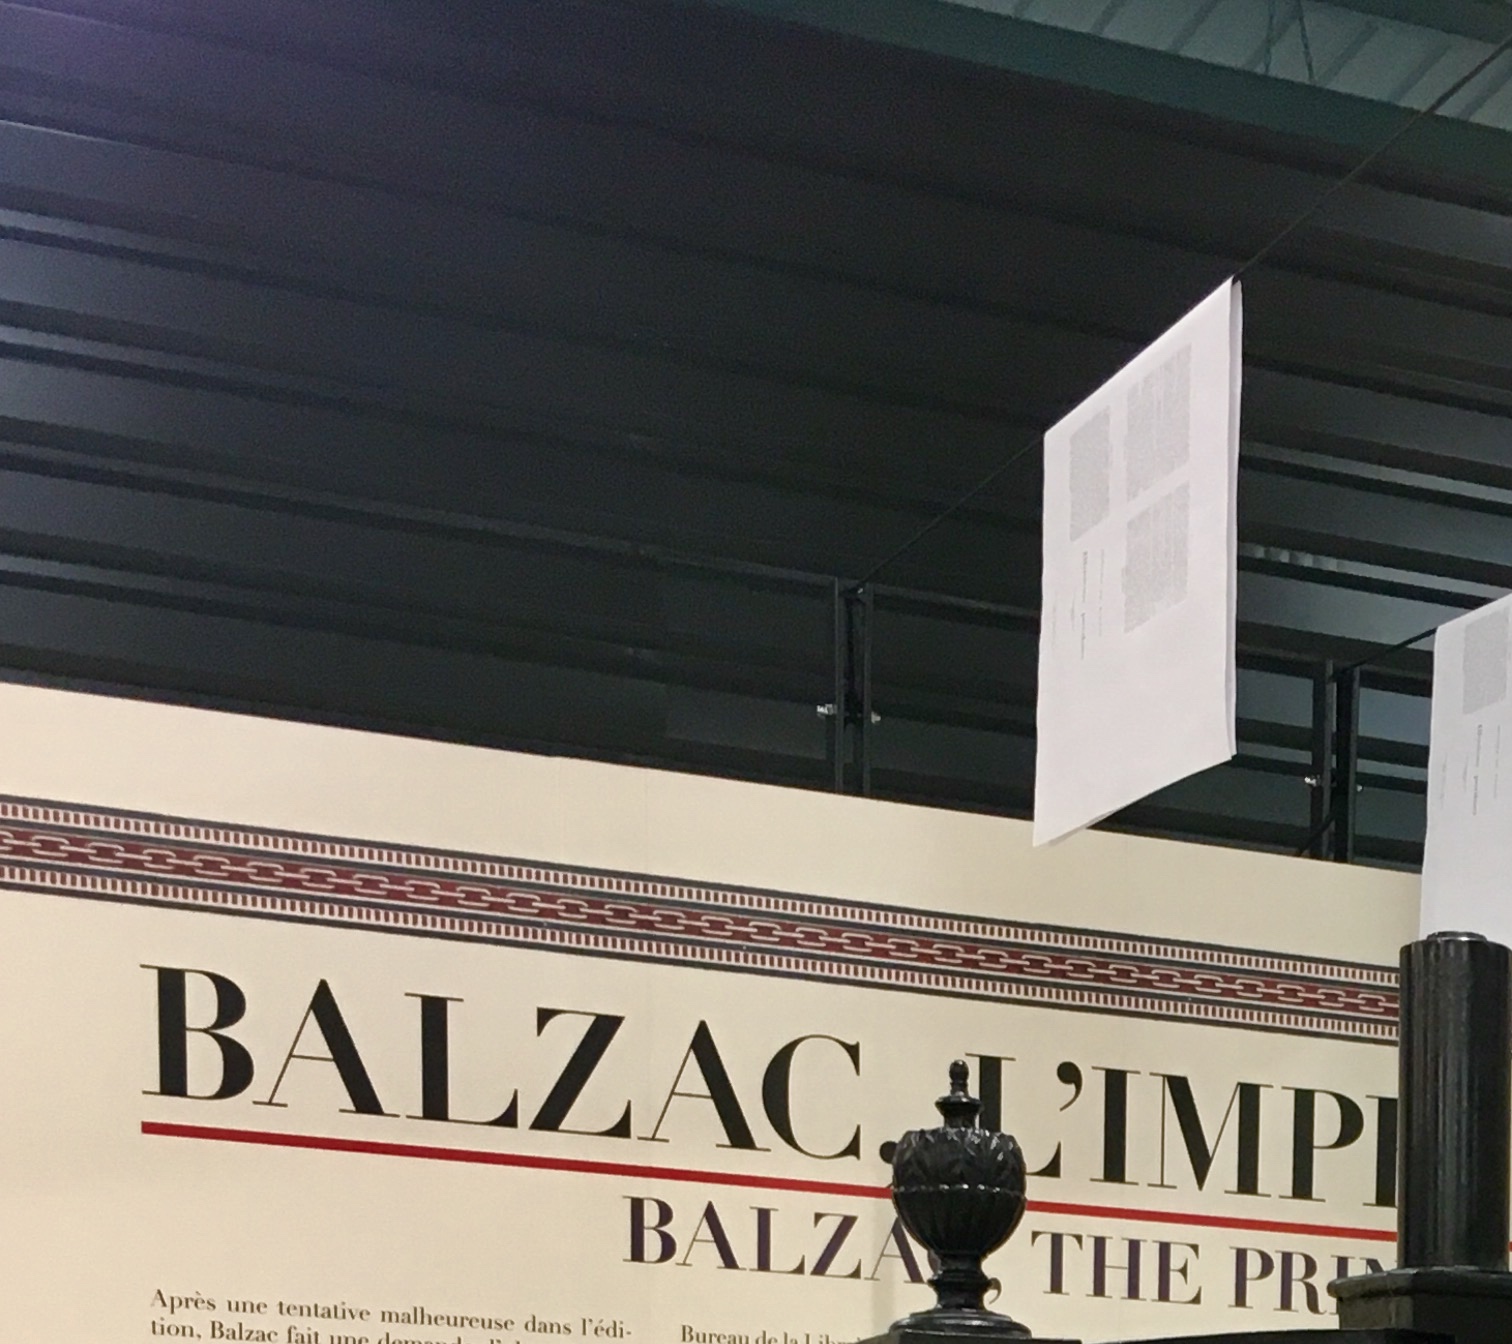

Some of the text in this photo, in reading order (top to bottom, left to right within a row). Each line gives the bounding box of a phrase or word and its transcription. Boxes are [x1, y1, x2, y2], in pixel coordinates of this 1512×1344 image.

[1030, 1229, 1202, 1305] THE
[150, 1288, 631, 1339] Après une tentative malheureuse dans l'édi-
[151, 1316, 201, 1340] tion,
[209, 1320, 278, 1342] Balzac
